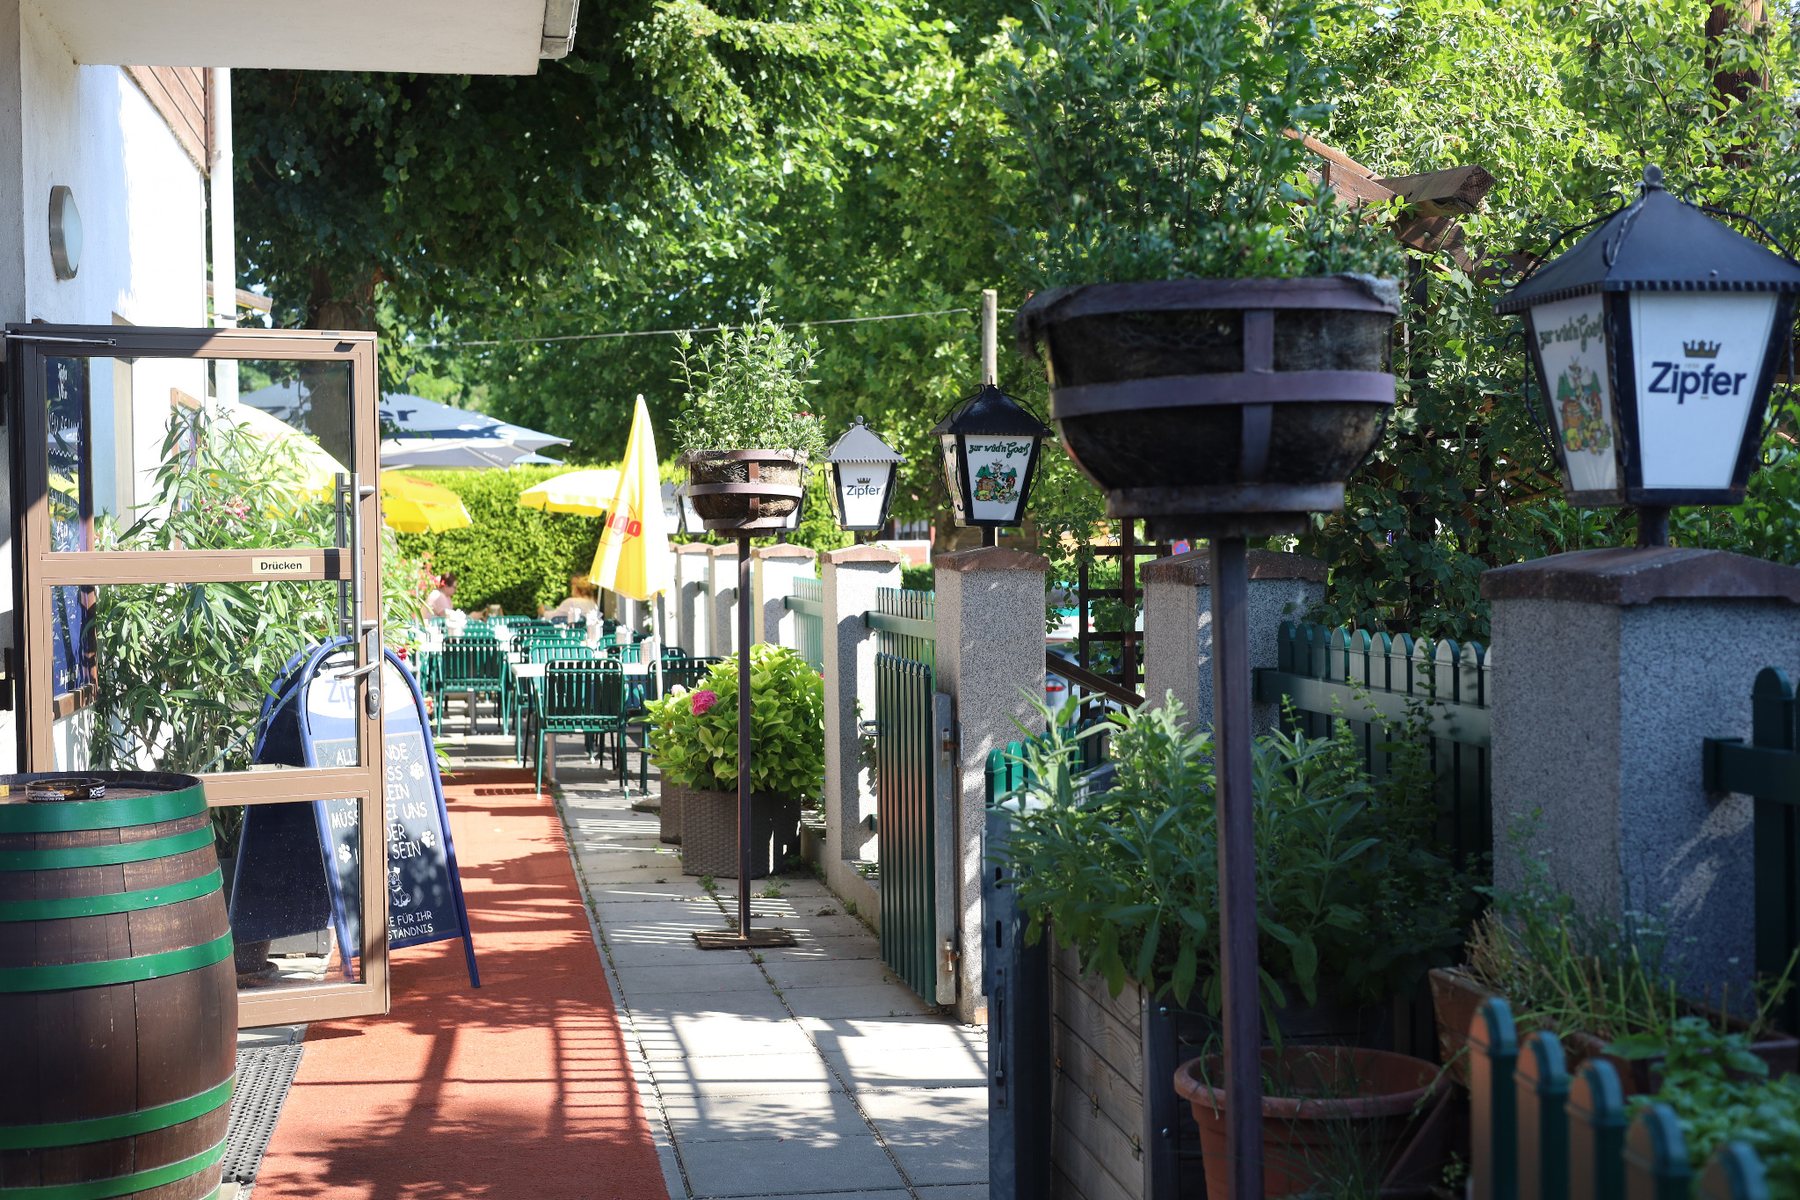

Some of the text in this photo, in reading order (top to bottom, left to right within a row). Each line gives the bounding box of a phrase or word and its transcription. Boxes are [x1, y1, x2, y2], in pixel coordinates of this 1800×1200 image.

[1648, 361, 1747, 405] Zipfer
[846, 484, 881, 499] Zipfer
[260, 561, 303, 571] Drücken
[402, 801, 428, 820] UNS
[392, 840, 422, 860] SEIN
[396, 912, 415, 926] FÜR
[415, 910, 433, 922] IHR
[388, 923, 434, 941] STÄNDNIS
